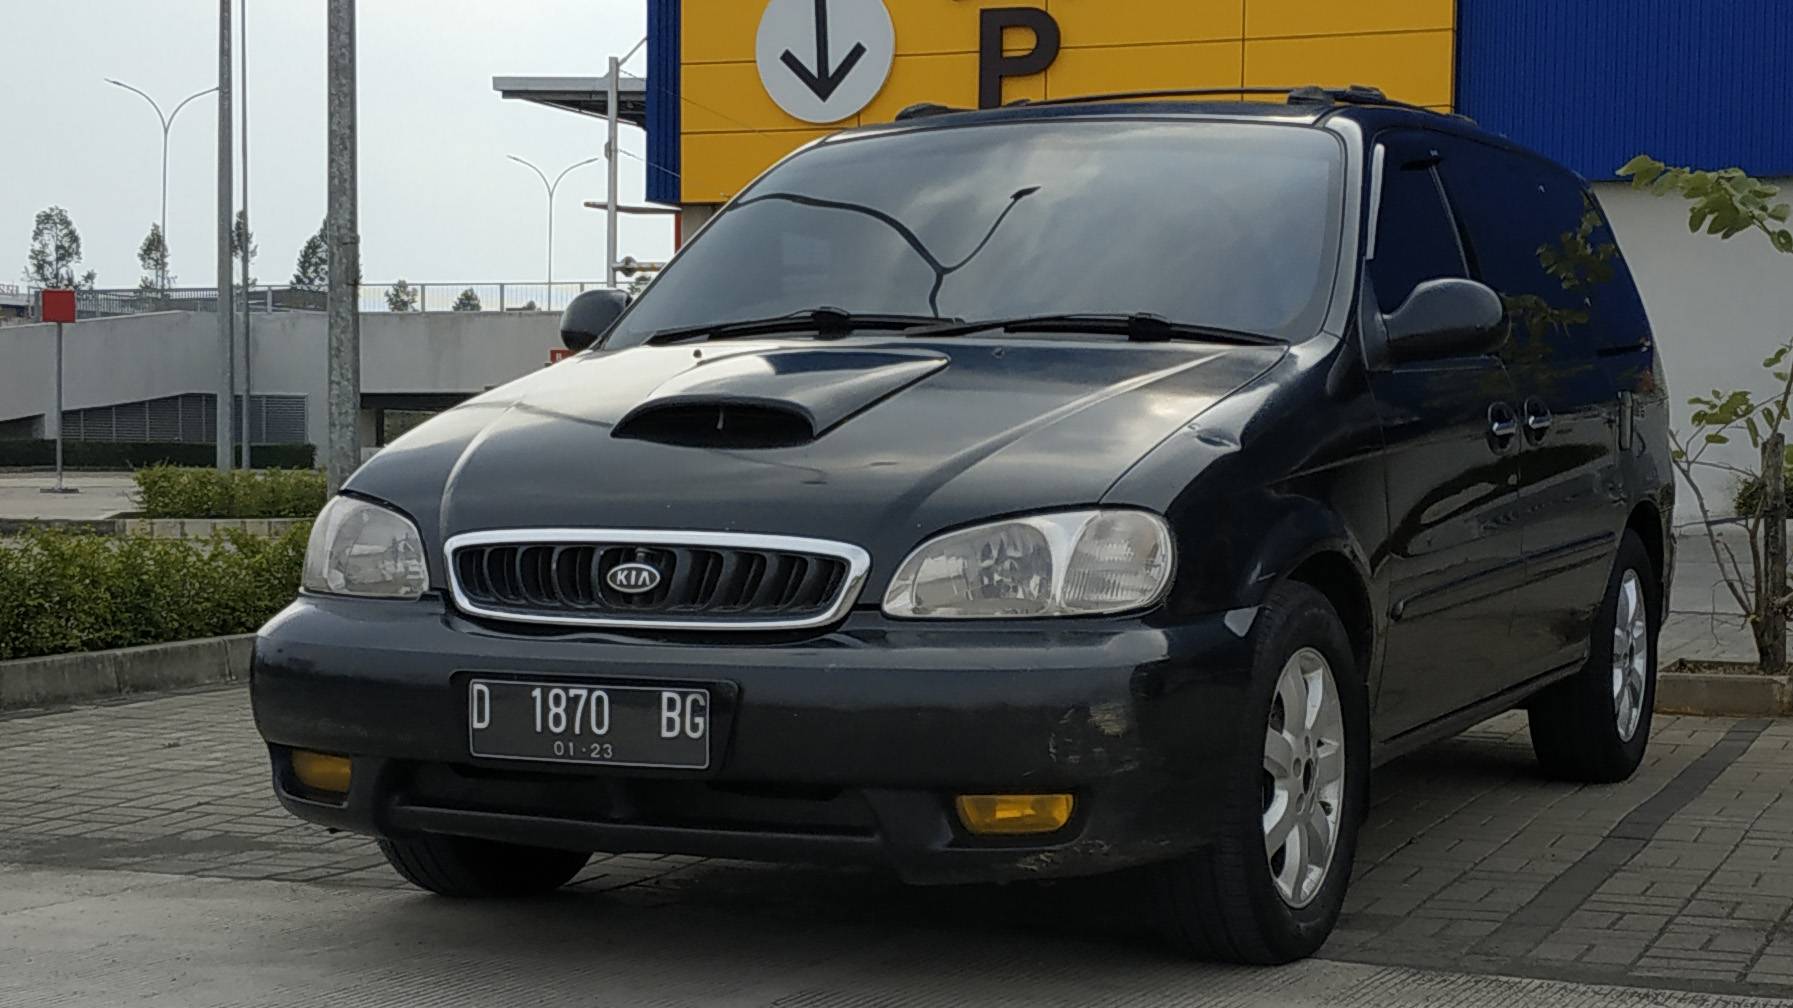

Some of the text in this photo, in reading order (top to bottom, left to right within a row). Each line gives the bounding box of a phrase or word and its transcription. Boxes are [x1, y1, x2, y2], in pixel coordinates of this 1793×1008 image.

[979, 7, 1061, 109] P
[616, 570, 650, 586] KIA
[472, 683, 705, 739] D 1870 BG
